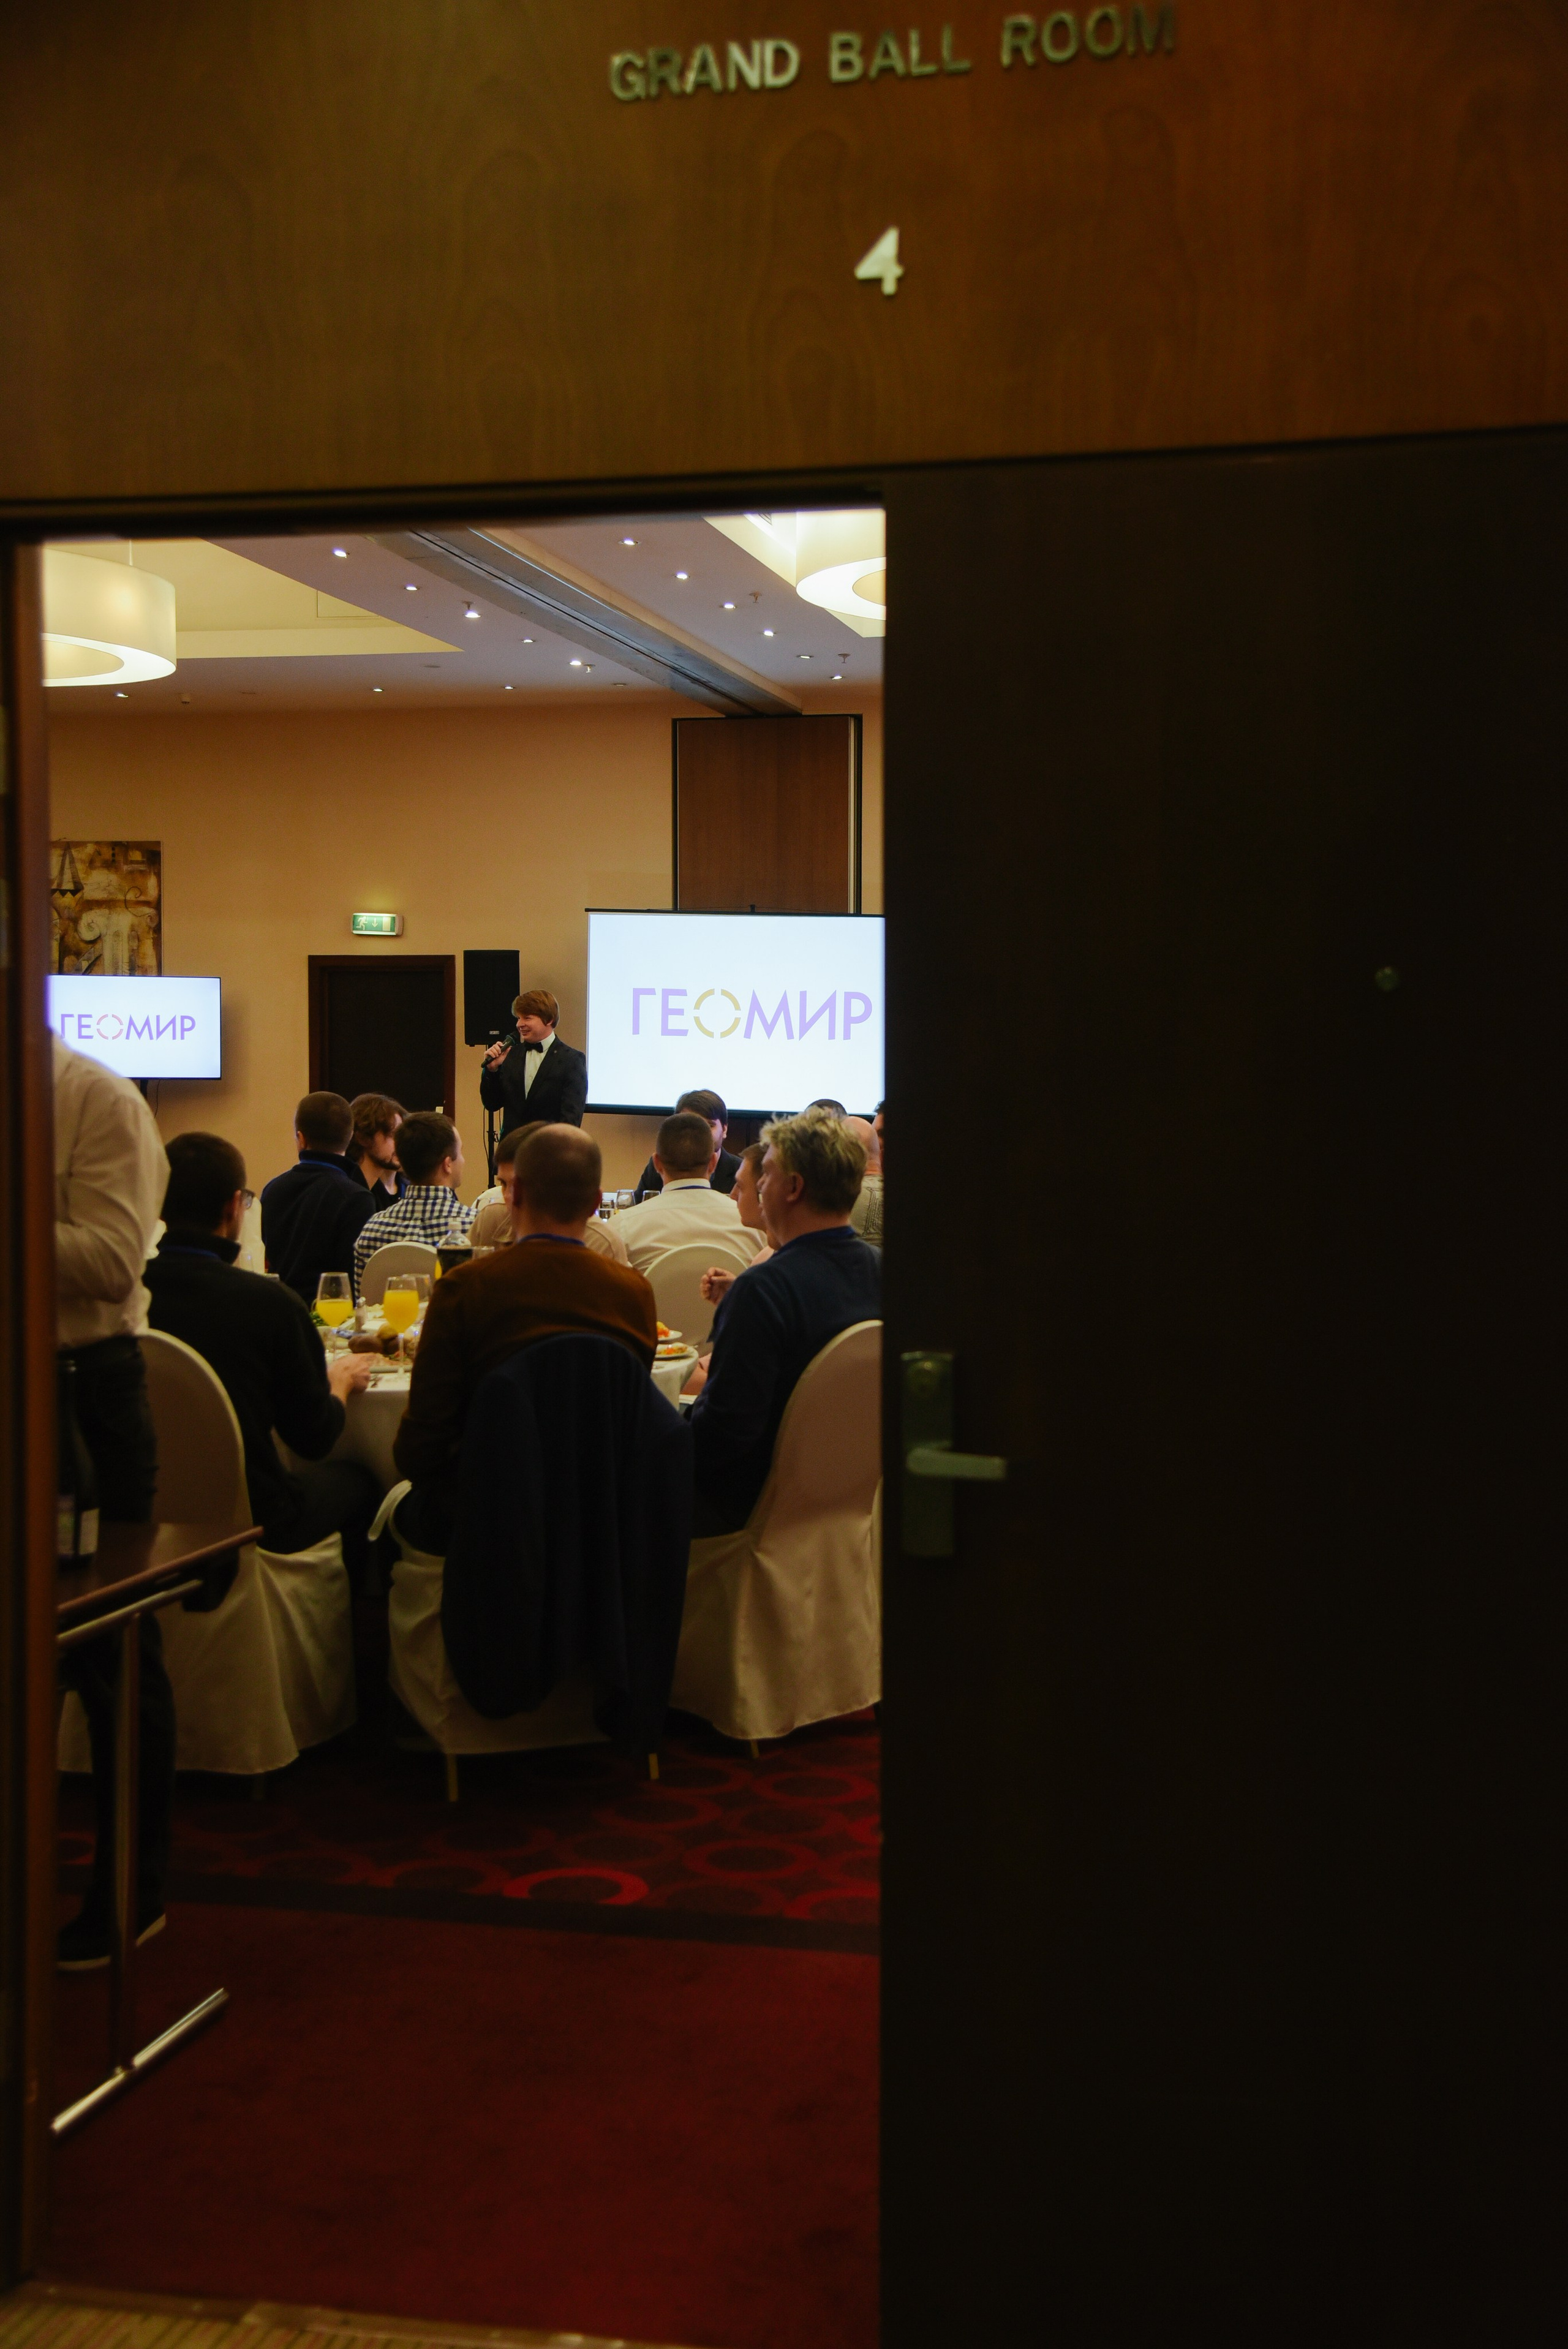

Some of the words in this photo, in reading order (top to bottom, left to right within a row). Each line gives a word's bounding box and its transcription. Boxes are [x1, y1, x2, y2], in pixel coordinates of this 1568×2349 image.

[611, 37, 801, 101] GRAND
[829, 25, 971, 83] BALL
[1000, 2, 1175, 68] ROOM
[854, 225, 903, 296] 4
[61, 1014, 196, 1041] ГЕОМИР
[632, 987, 873, 1041] ГЕОМИР
